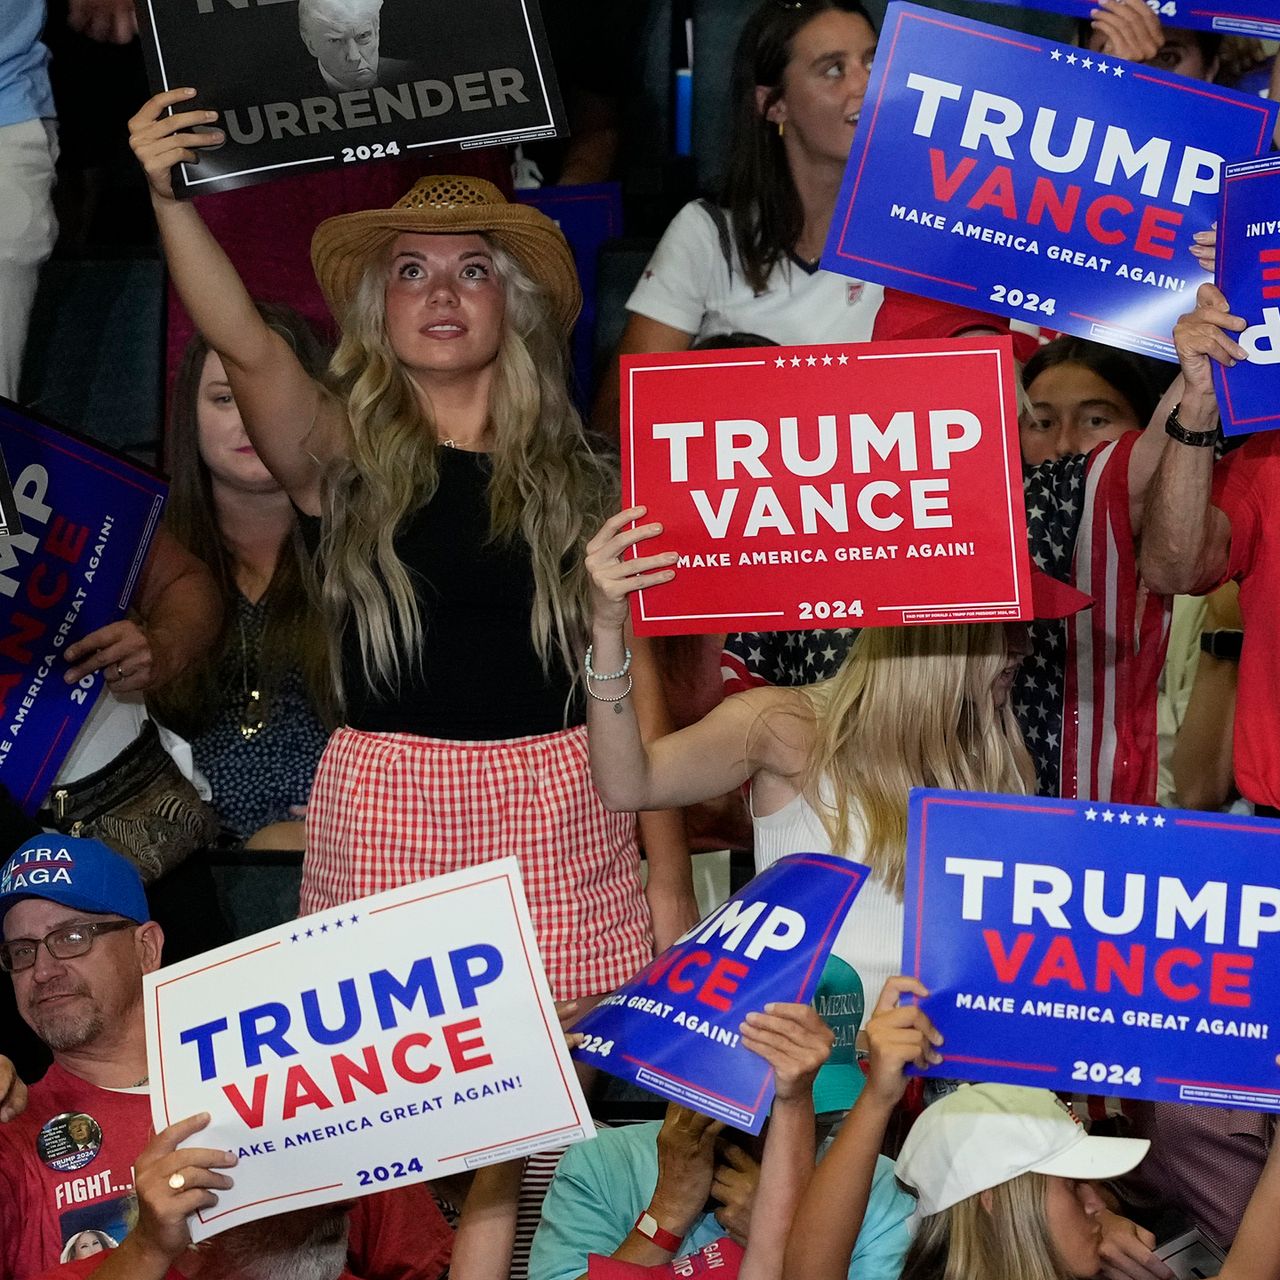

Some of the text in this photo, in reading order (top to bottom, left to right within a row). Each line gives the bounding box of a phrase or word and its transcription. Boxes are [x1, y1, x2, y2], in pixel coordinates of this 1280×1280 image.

[342, 142, 400, 162] 2024
[906, 73, 1225, 206] TRUMP
[931, 150, 1181, 258] VANCE
[990, 285, 1055, 315] 2024
[653, 410, 981, 482] TRUMP
[690, 479, 952, 538] VANCE
[675, 543, 974, 570] MAKE AMERICA GREAT AGAIN!
[799, 600, 863, 619] 2024
[985, 932, 1252, 1005] VANCE
[180, 944, 503, 1083] TRUMP
[956, 994, 1268, 1039] MAKE AMERICA GREAT AGAIN!
[222, 1018, 493, 1138] VANCE
[1072, 1061, 1141, 1086] 2024
[357, 1158, 423, 1186] 2024
